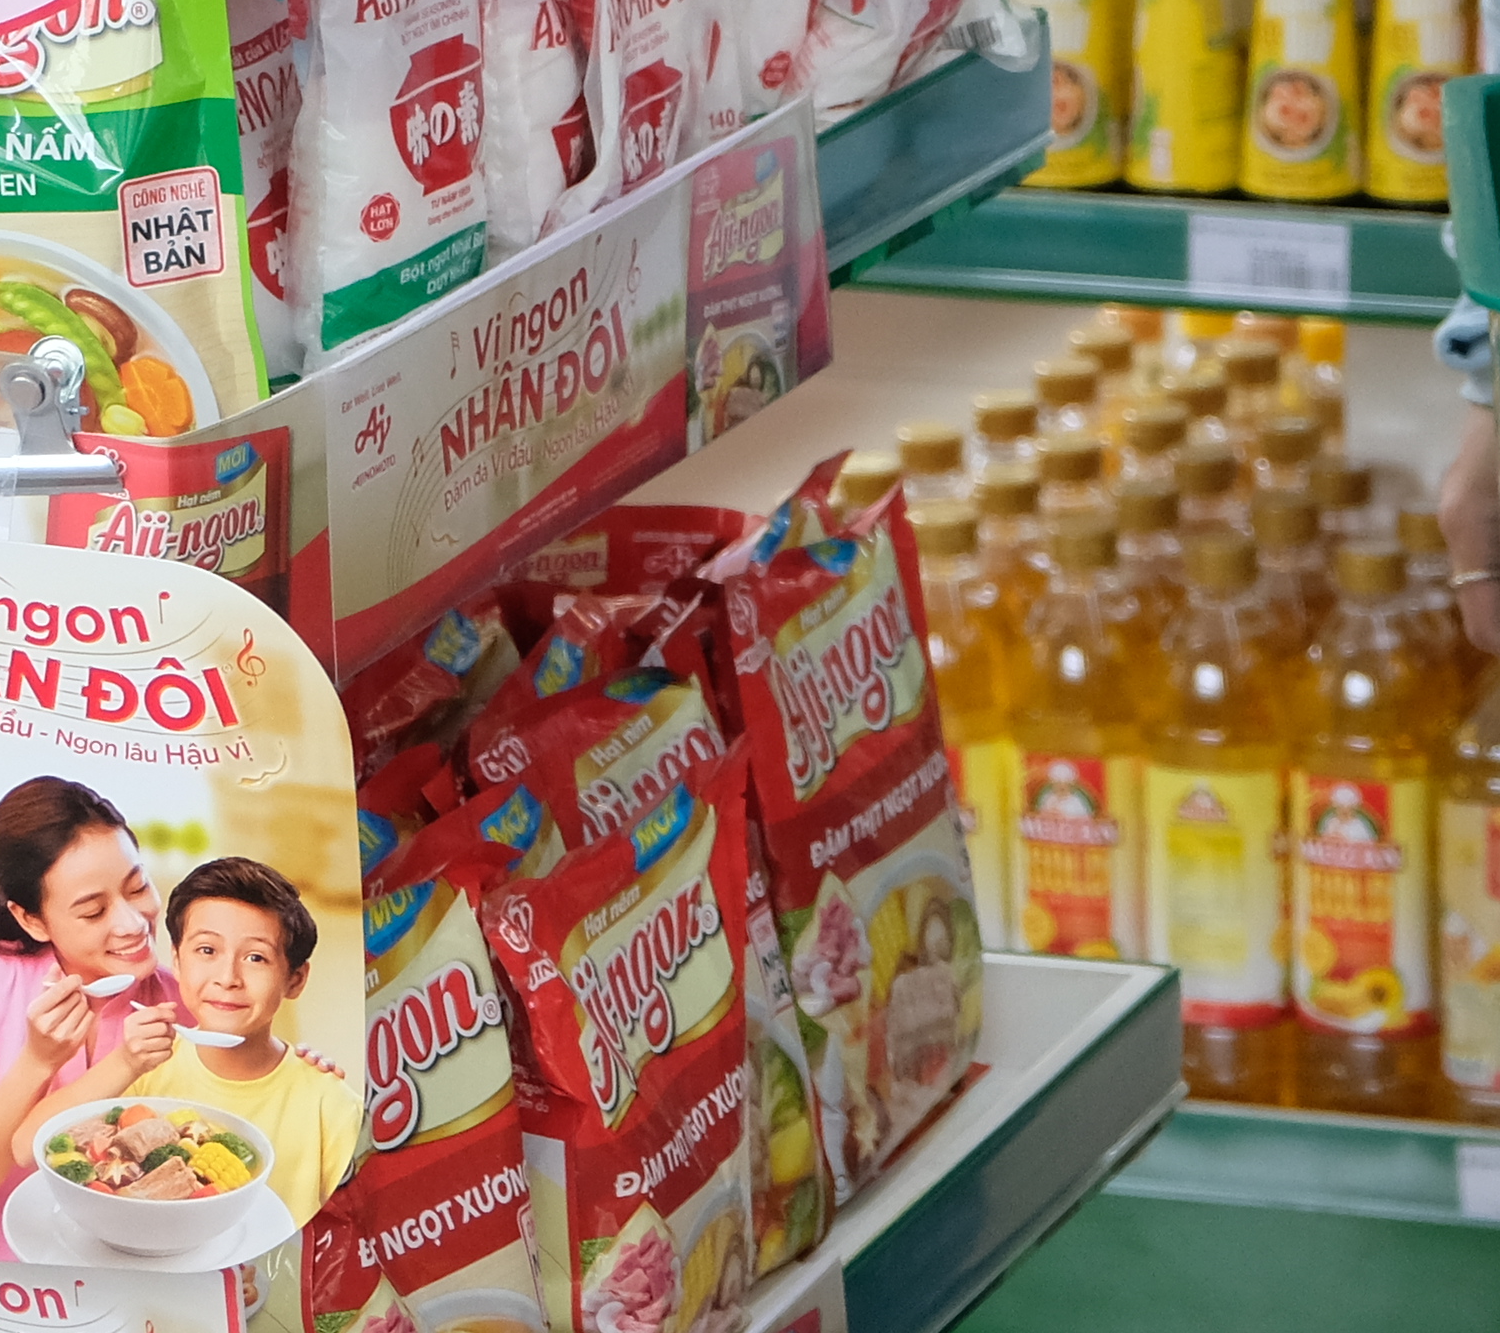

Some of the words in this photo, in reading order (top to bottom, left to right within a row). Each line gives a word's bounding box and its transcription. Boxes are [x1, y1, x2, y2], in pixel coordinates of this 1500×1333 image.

[131, 207, 214, 245] NHẬT
[144, 240, 207, 274] BẢN
[472, 314, 502, 374] Vị
[512, 268, 590, 356] ngon
[440, 361, 546, 477] NHÂN
[555, 300, 629, 417] ĐÔI
[82, 657, 240, 732] ĐÔI
[55, 729, 118, 759] Ngon
[125, 742, 157, 764] lâu
[166, 743, 219, 770] Hậu
[225, 736, 254, 762] vị
